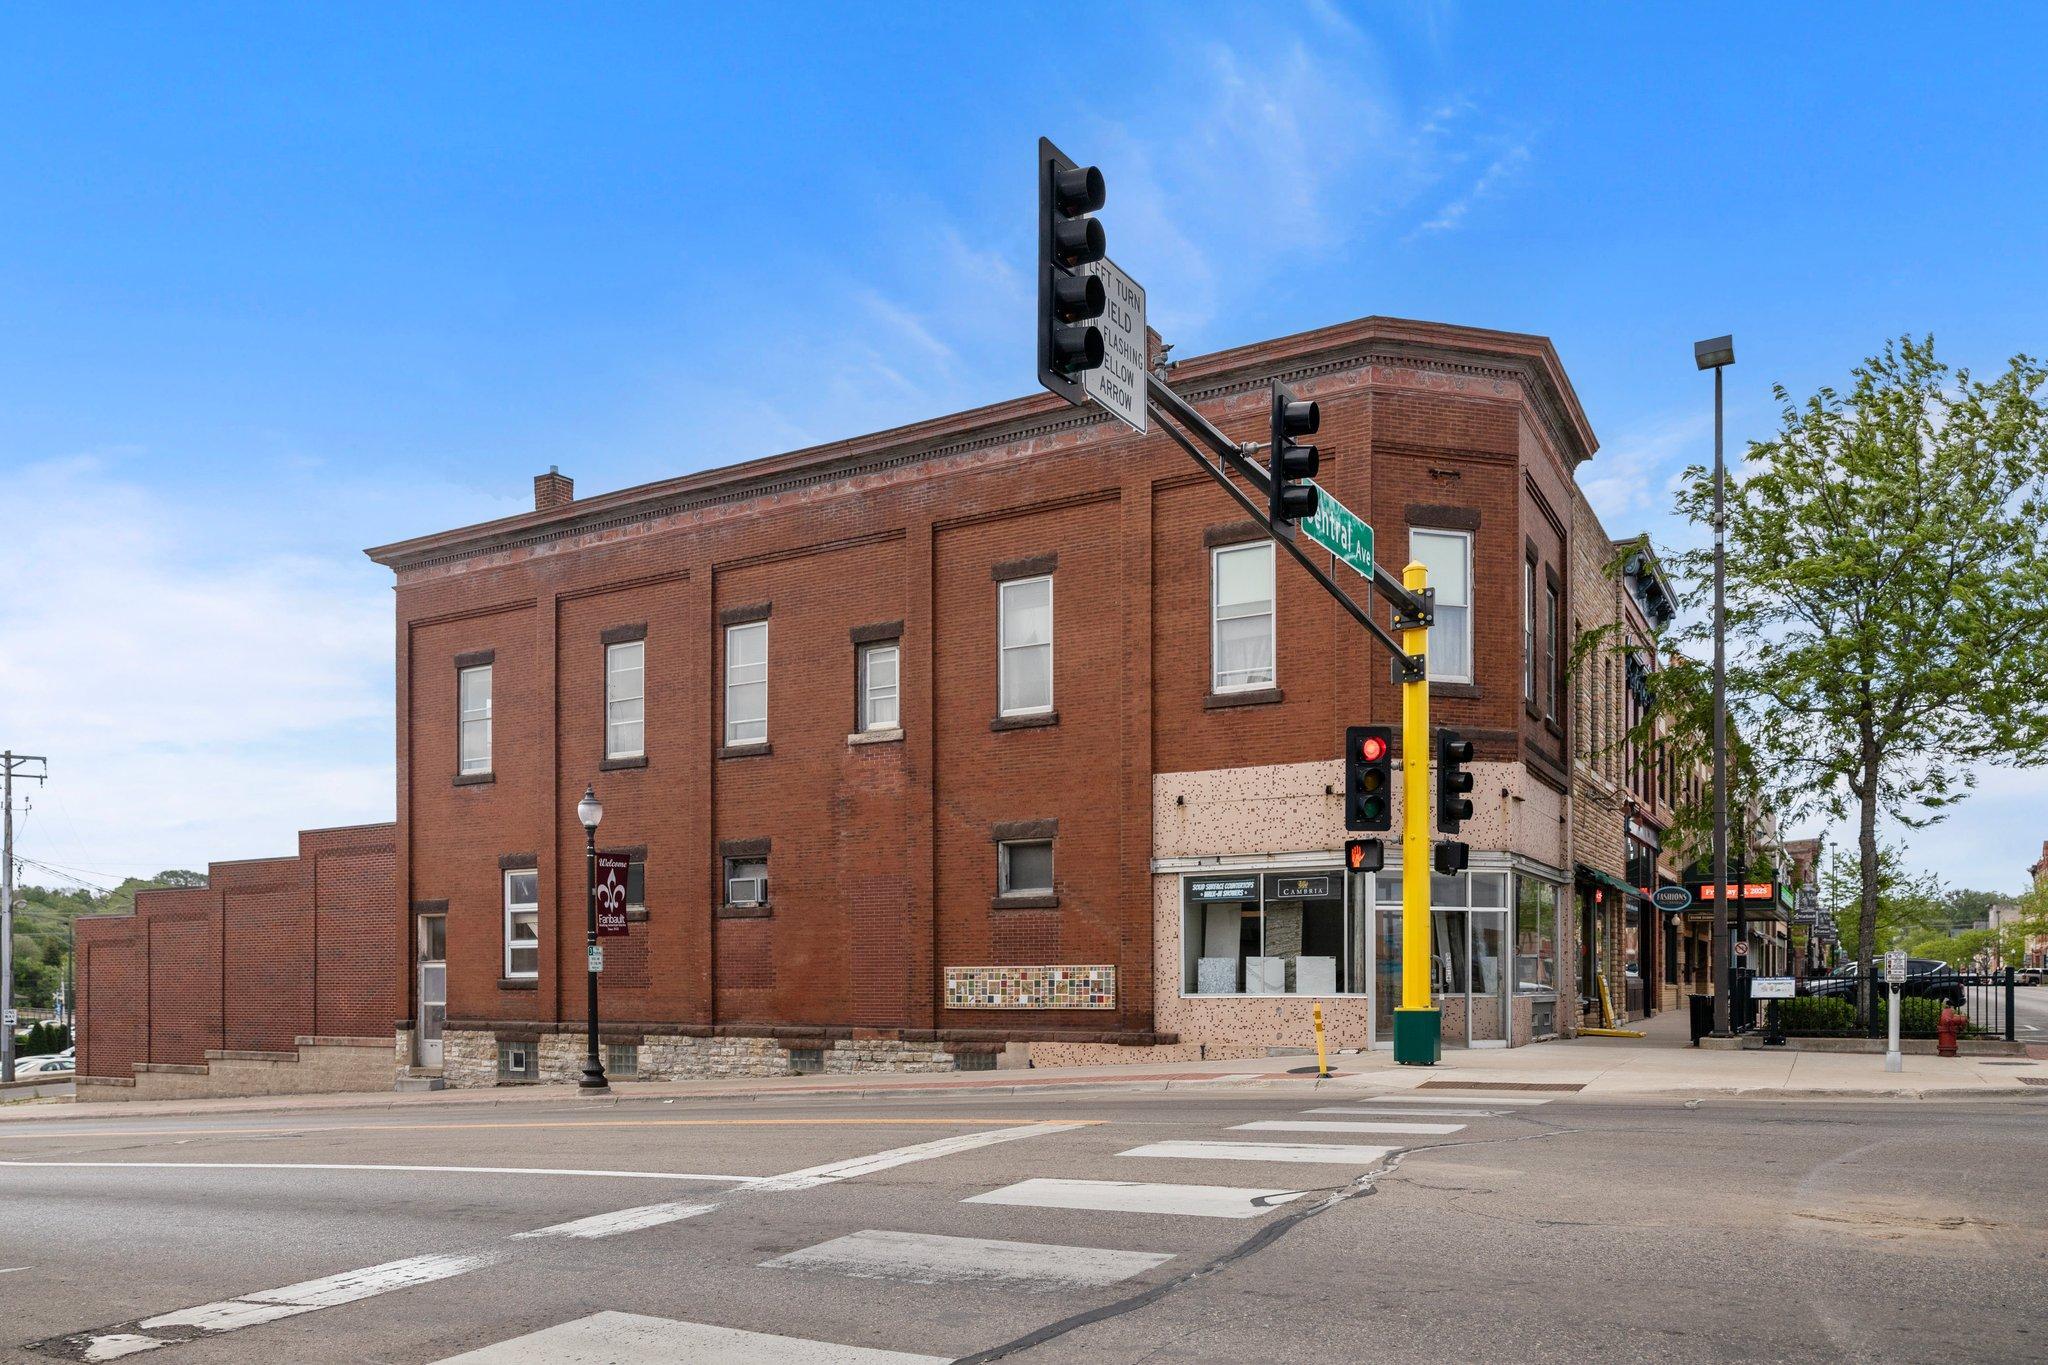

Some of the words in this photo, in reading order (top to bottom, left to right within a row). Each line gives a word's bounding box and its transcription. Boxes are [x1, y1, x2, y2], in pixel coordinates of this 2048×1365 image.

[1116, 278, 1140, 313] TURN
[1105, 296, 1132, 334] IELD
[1103, 325, 1143, 371] FLASHING
[1104, 351, 1134, 389] ELLOW
[1100, 375, 1132, 412] ARROW
[1307, 506, 1351, 552] entral
[1355, 540, 1371, 566] Ave
[599, 858, 627, 868] Welcome
[1283, 888, 1323, 896] CAMBRIA
[1656, 893, 1687, 901] FASHIONS
[598, 913, 626, 924] Faribault
